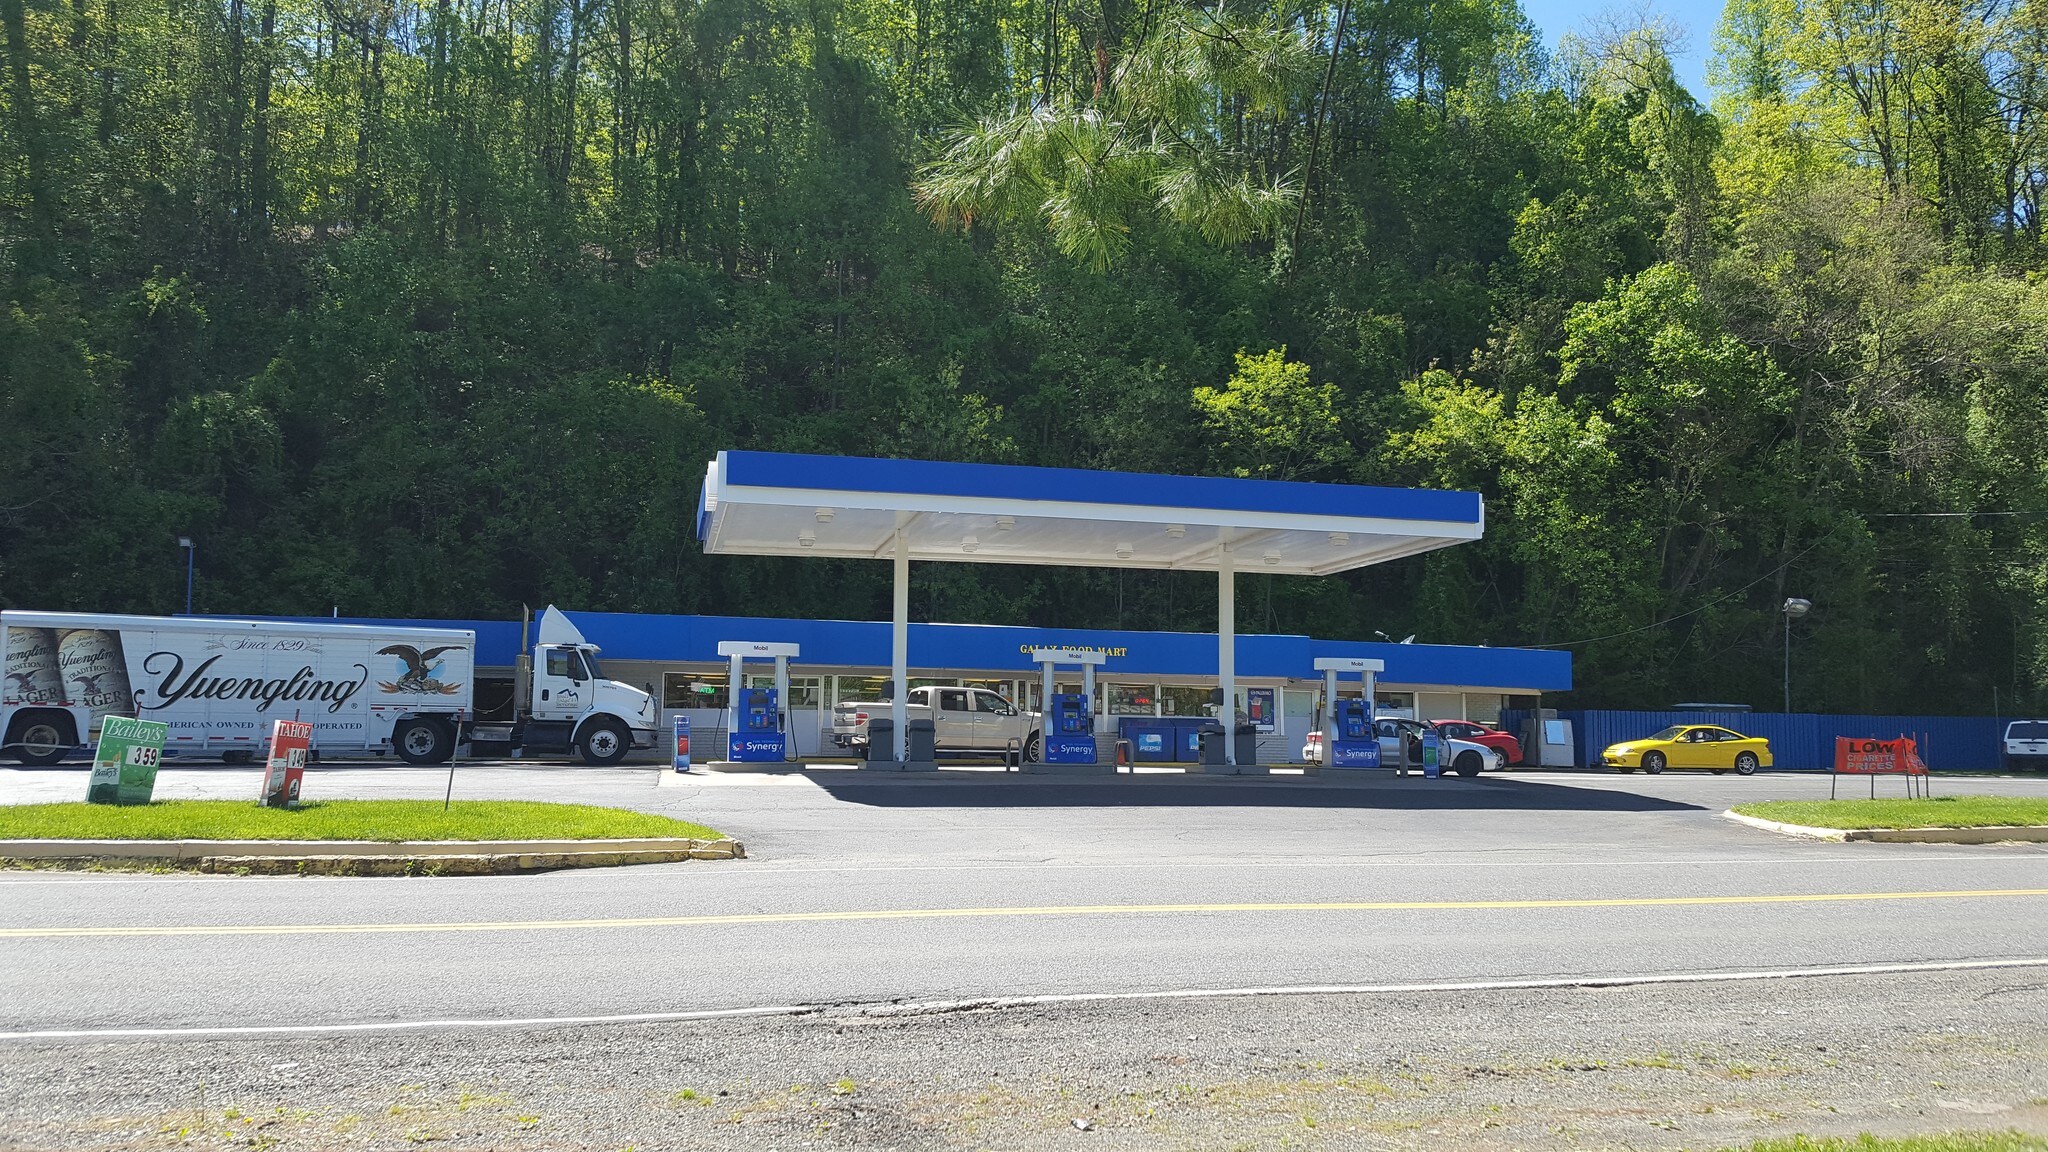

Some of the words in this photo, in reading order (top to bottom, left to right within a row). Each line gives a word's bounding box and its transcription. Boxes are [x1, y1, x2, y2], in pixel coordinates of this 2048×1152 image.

[230, 637, 268, 650] Since
[272, 639, 305, 651] 1829
[1097, 647, 1127, 657] MART
[134, 651, 368, 714] Yuengling
[166, 721, 212, 729] MERICAN
[216, 721, 255, 729] OWNED
[312, 722, 363, 730] OPERATED
[279, 722, 311, 739] TAHOE
[106, 720, 163, 743] Bailey's
[746, 741, 783, 753] Synergy
[1060, 744, 1093, 755] Synergy
[1848, 742, 1896, 754] LOW
[1346, 749, 1377, 760] Synergy
[1847, 754, 1896, 762] CIGARETTE
[1846, 761, 1894, 771] PRICES
